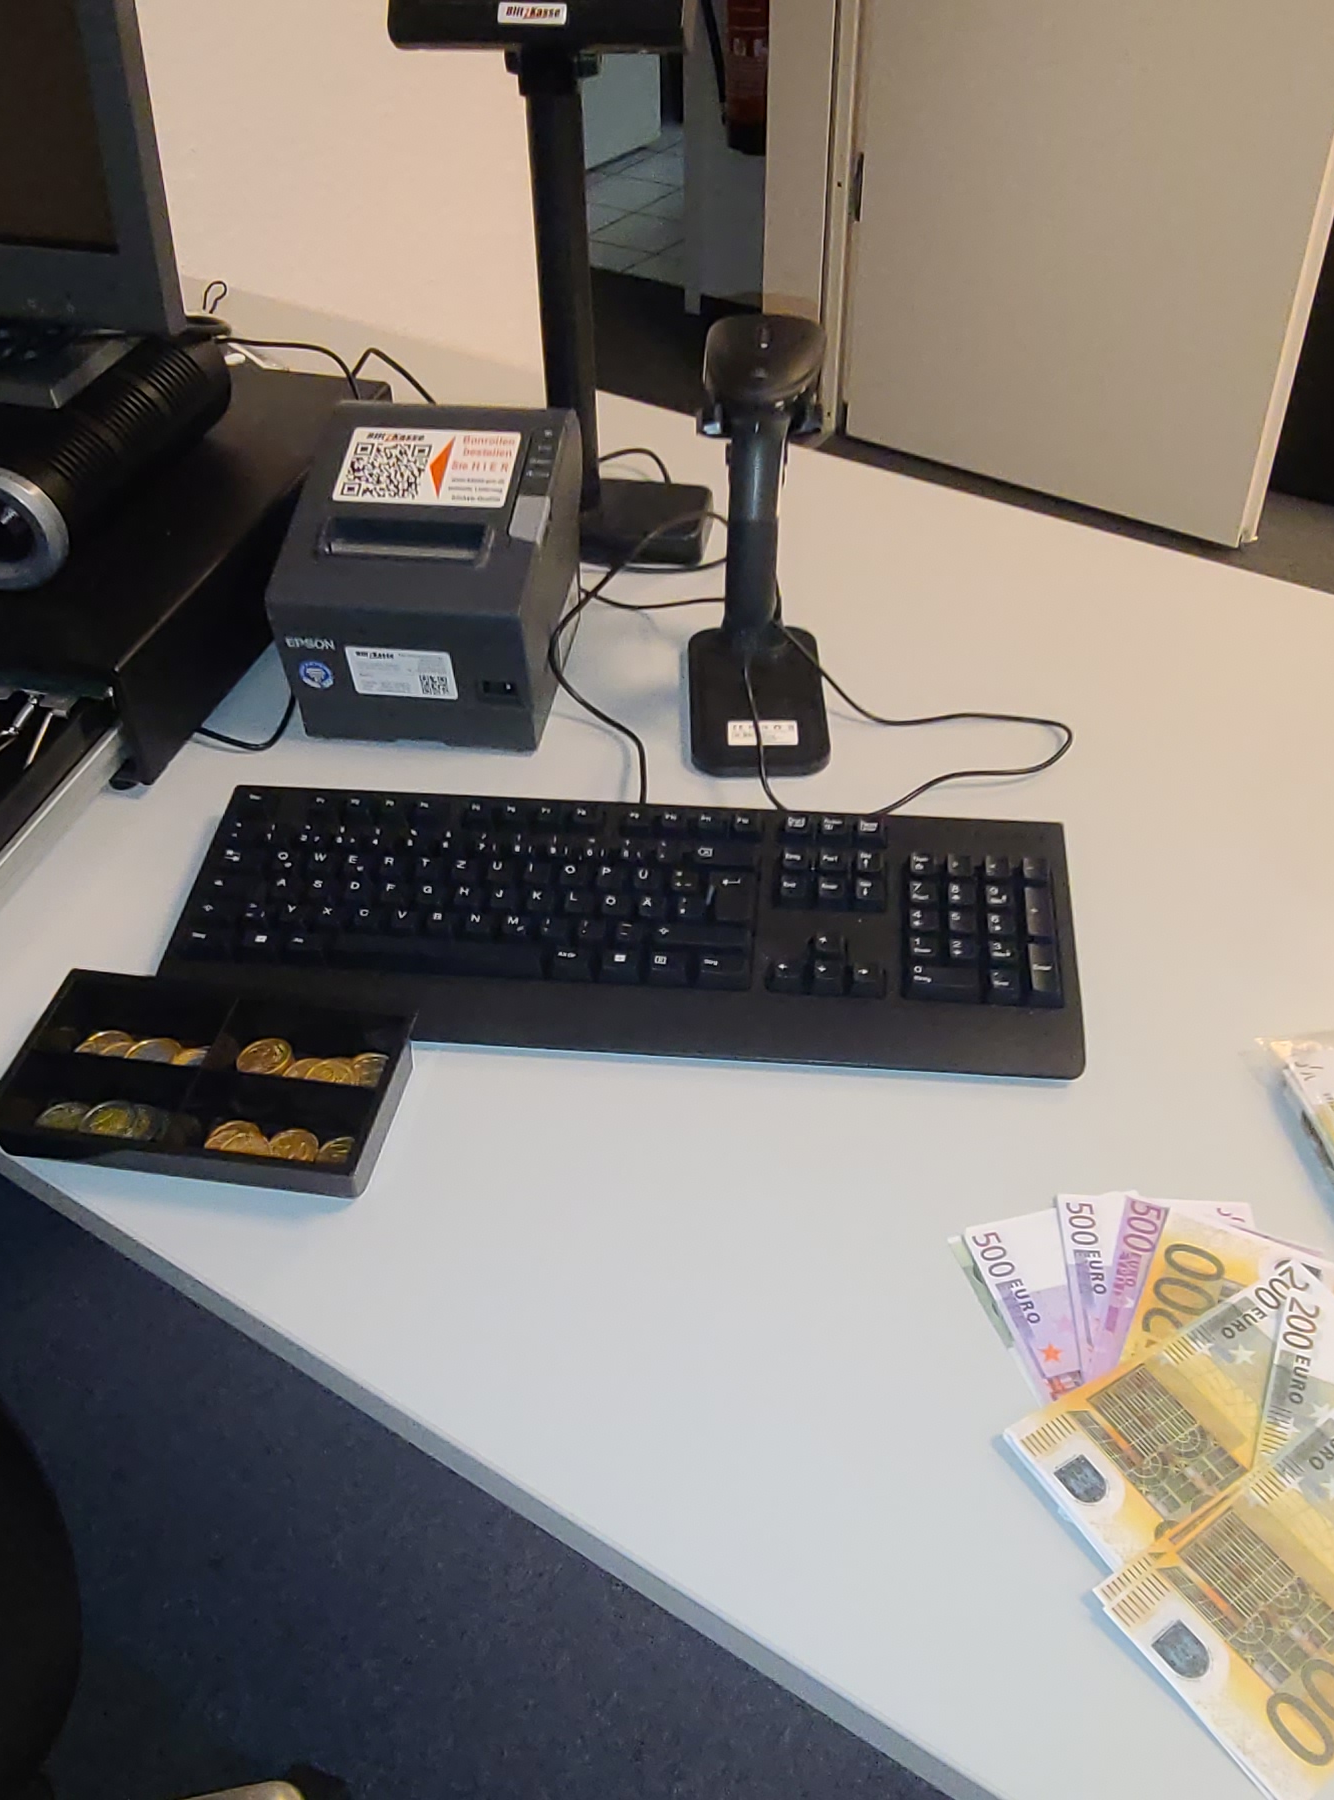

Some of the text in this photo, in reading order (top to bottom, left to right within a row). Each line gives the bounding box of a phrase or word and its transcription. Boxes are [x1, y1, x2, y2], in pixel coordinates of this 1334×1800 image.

[285, 636, 335, 650] EPSON
[314, 852, 327, 862] W
[347, 854, 359, 865] E
[383, 856, 395, 866] R
[421, 857, 431, 868] T
[455, 859, 467, 870] Z
[492, 860, 503, 871] U
[601, 865, 612, 876] P
[276, 878, 287, 888] A
[312, 879, 324, 889] S
[349, 880, 361, 890] D
[385, 882, 396, 892] F
[422, 885, 433, 894] G
[458, 886, 470, 896] H
[494, 889, 504, 898] J
[531, 890, 542, 901] K
[569, 891, 578, 902] L
[951, 884, 961, 894] 8
[988, 886, 999, 895] 9
[287, 904, 520, 925] Y X C V B N M
[911, 909, 923, 919] 4
[952, 940, 962, 949] 2
[992, 942, 1003, 951] 3
[1122, 1199, 1162, 1253] 500
[1066, 1202, 1107, 1296] 500 EURO
[971, 1231, 1041, 1325] 500 EURO
[1221, 1265, 1310, 1340] 200 EURO
[1282, 1296, 1320, 1405] 200 EURO
